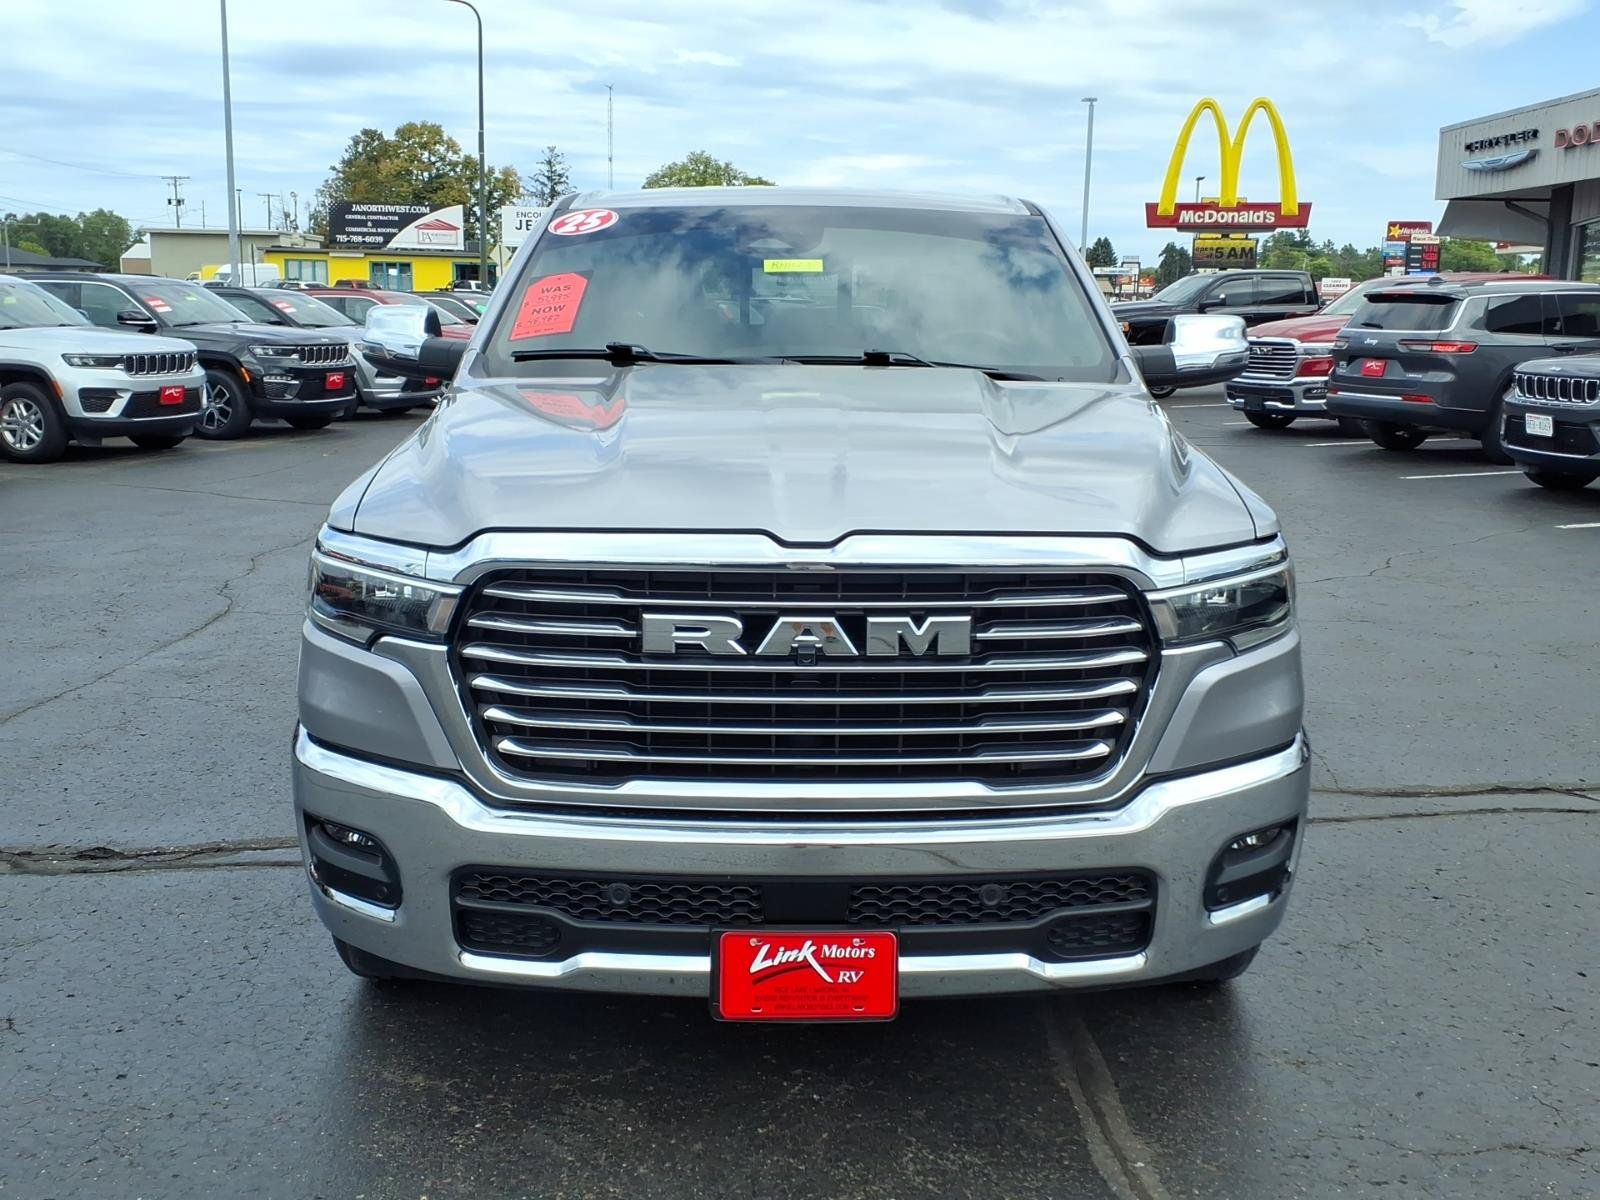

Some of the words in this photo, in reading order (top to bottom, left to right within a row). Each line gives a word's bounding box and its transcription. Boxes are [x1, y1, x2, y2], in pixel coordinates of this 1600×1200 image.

[1464, 128, 1540, 152] CHRYSLER
[351, 204, 430, 214] JANORTHWEST.COM
[560, 210, 606, 232] 25
[1179, 210, 1276, 223] McDonald's
[515, 219, 538, 231] JE
[1227, 246, 1254, 260] AM
[541, 284, 572, 294] WAS
[531, 304, 566, 315] NOW
[641, 612, 972, 656] RAM
[749, 939, 834, 984] Link
[821, 944, 876, 959] Motors
[837, 970, 864, 984] RV
